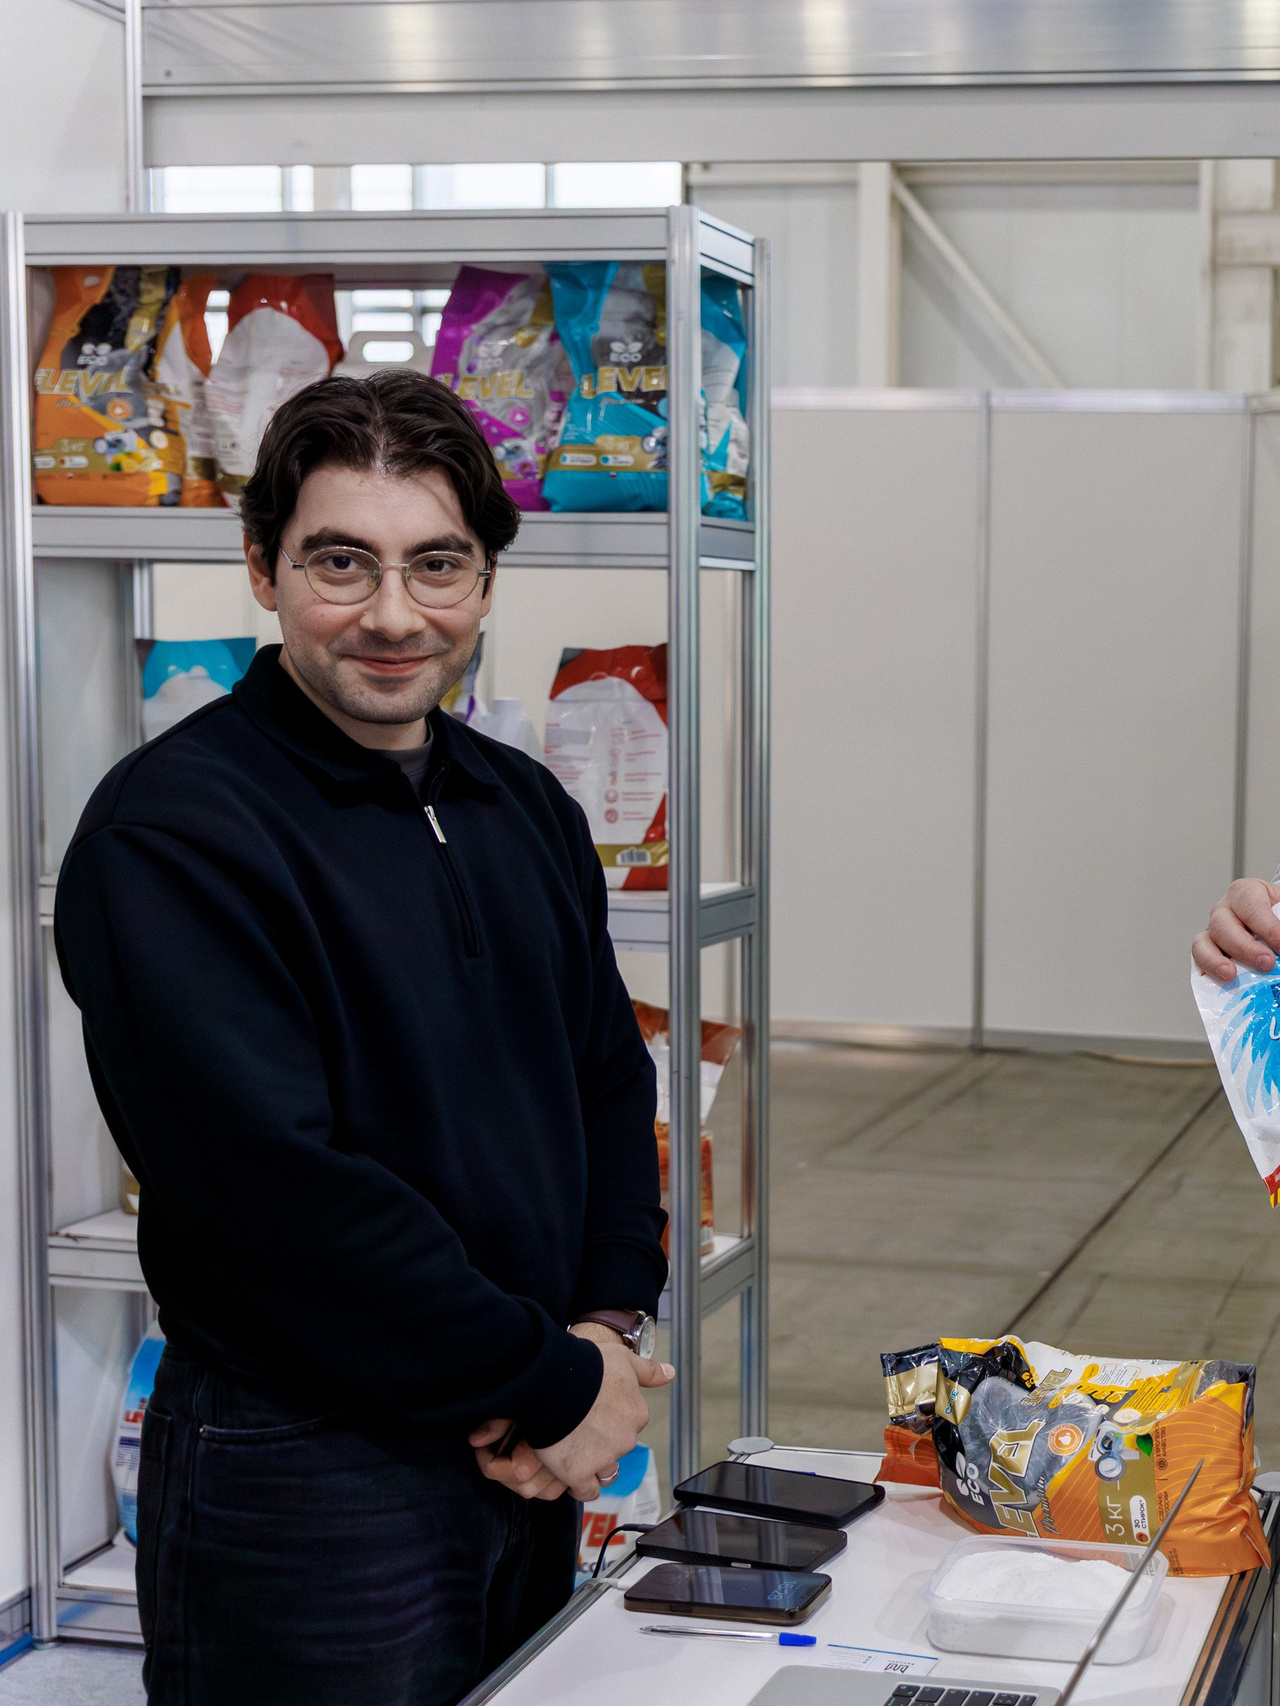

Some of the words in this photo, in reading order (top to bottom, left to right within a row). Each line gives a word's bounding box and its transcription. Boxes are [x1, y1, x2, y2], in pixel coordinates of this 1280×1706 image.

[609, 352, 642, 363] ECO
[580, 365, 667, 399] LEVE
[1024, 1373, 1040, 1389] ECO
[966, 1462, 985, 1506] ECO
[986, 1417, 1048, 1538] EVEL
[1157, 1492, 1165, 1522] СДЕЛАНО
[1105, 1523, 1125, 1537] 3
[1134, 1519, 1140, 1529] 30
